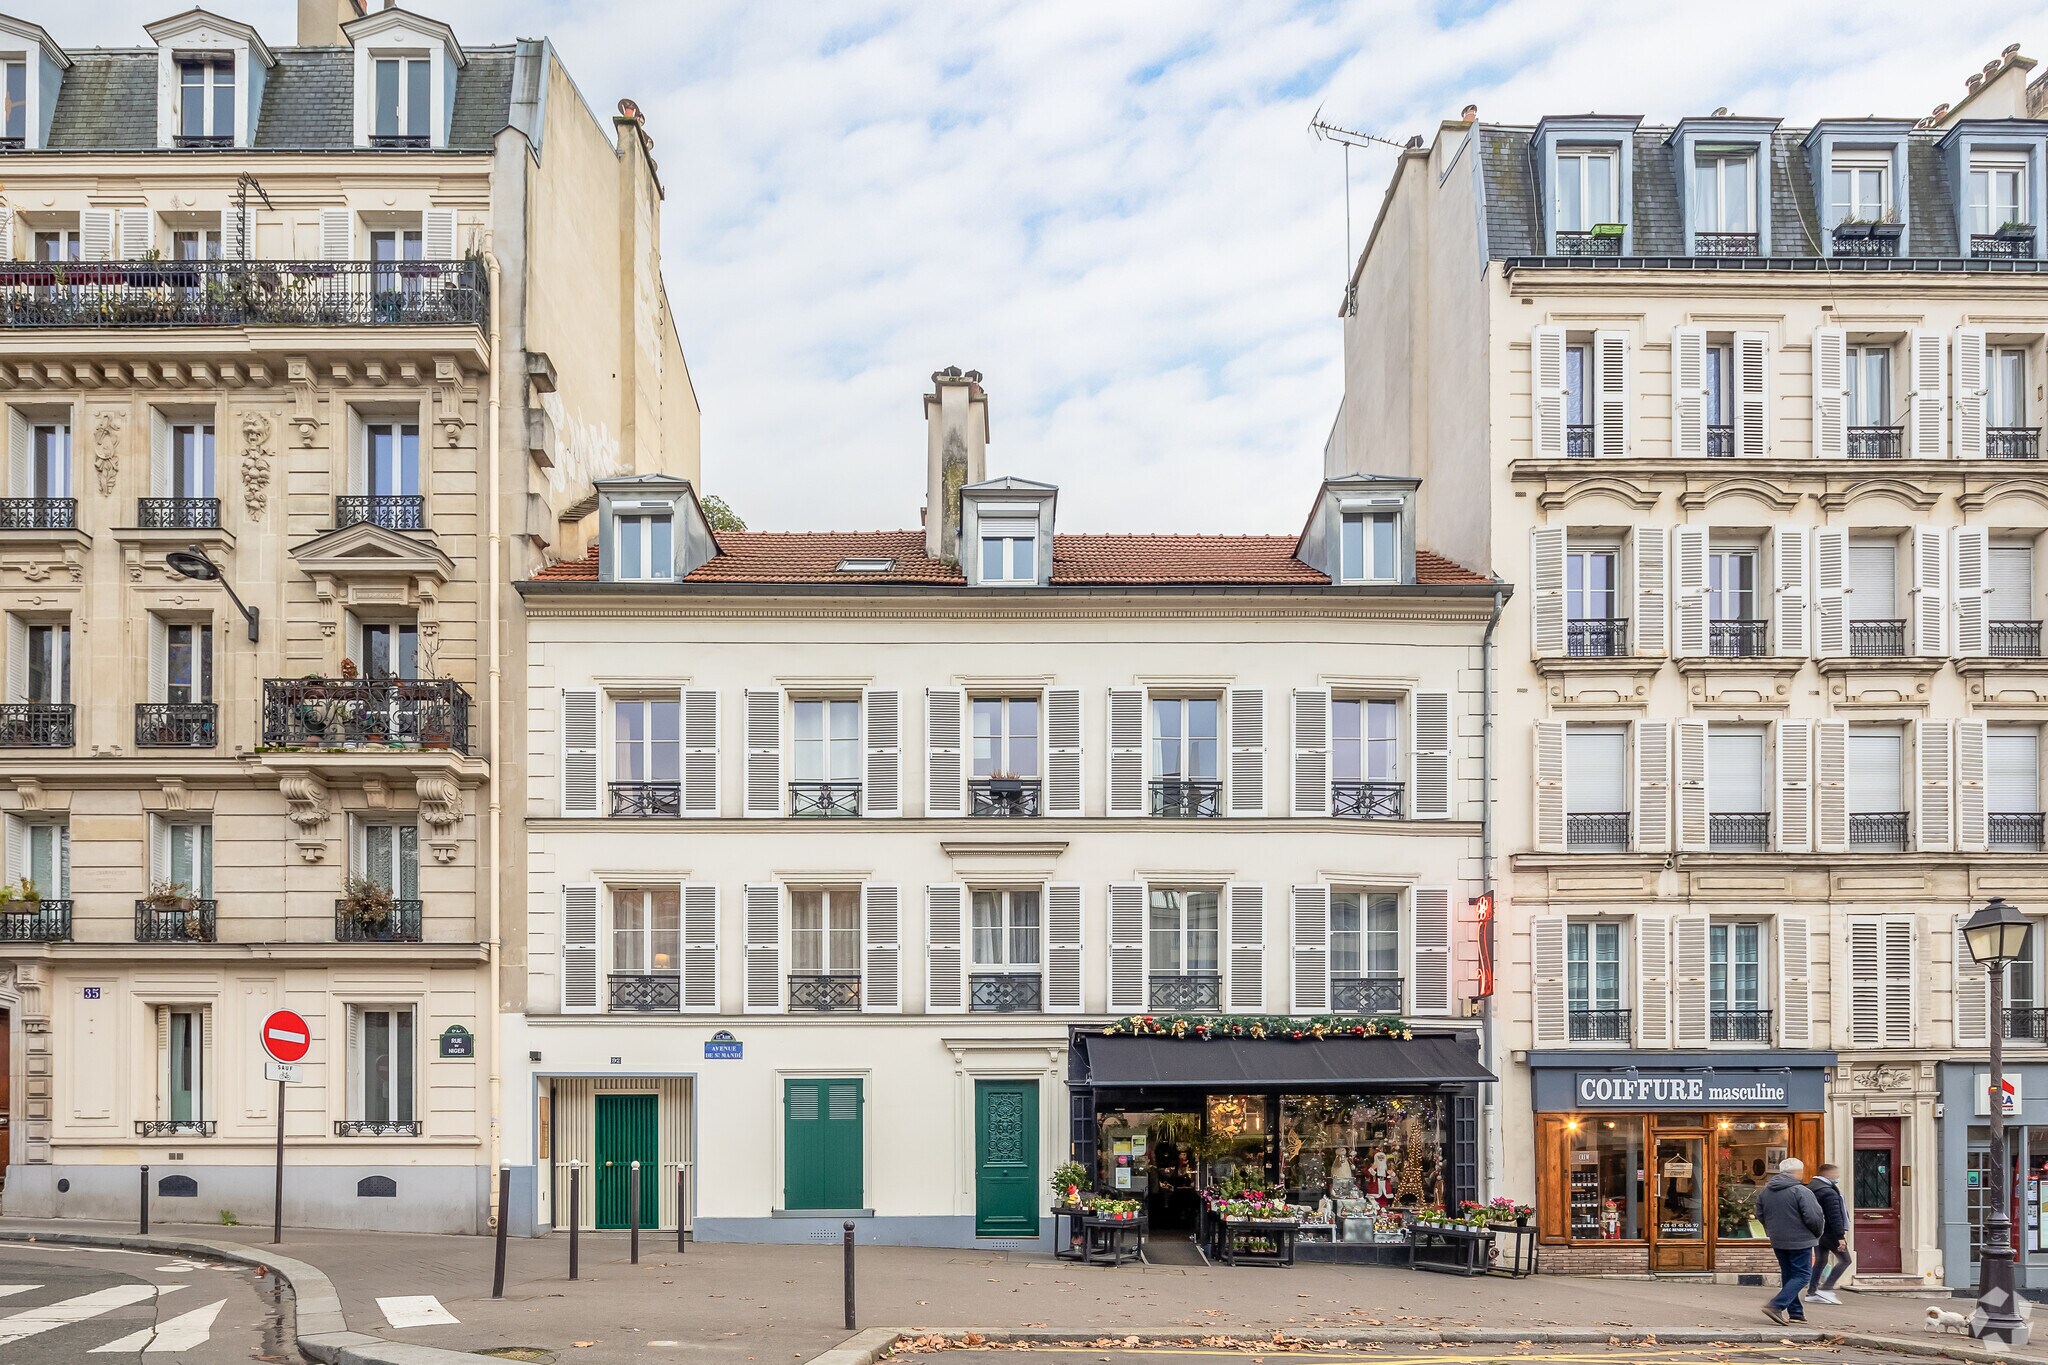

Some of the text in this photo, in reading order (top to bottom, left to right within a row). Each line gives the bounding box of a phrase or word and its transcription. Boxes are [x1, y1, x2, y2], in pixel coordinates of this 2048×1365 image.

[85, 988, 99, 999] 35
[1581, 1078, 1785, 1101] COIFFURE masculine
